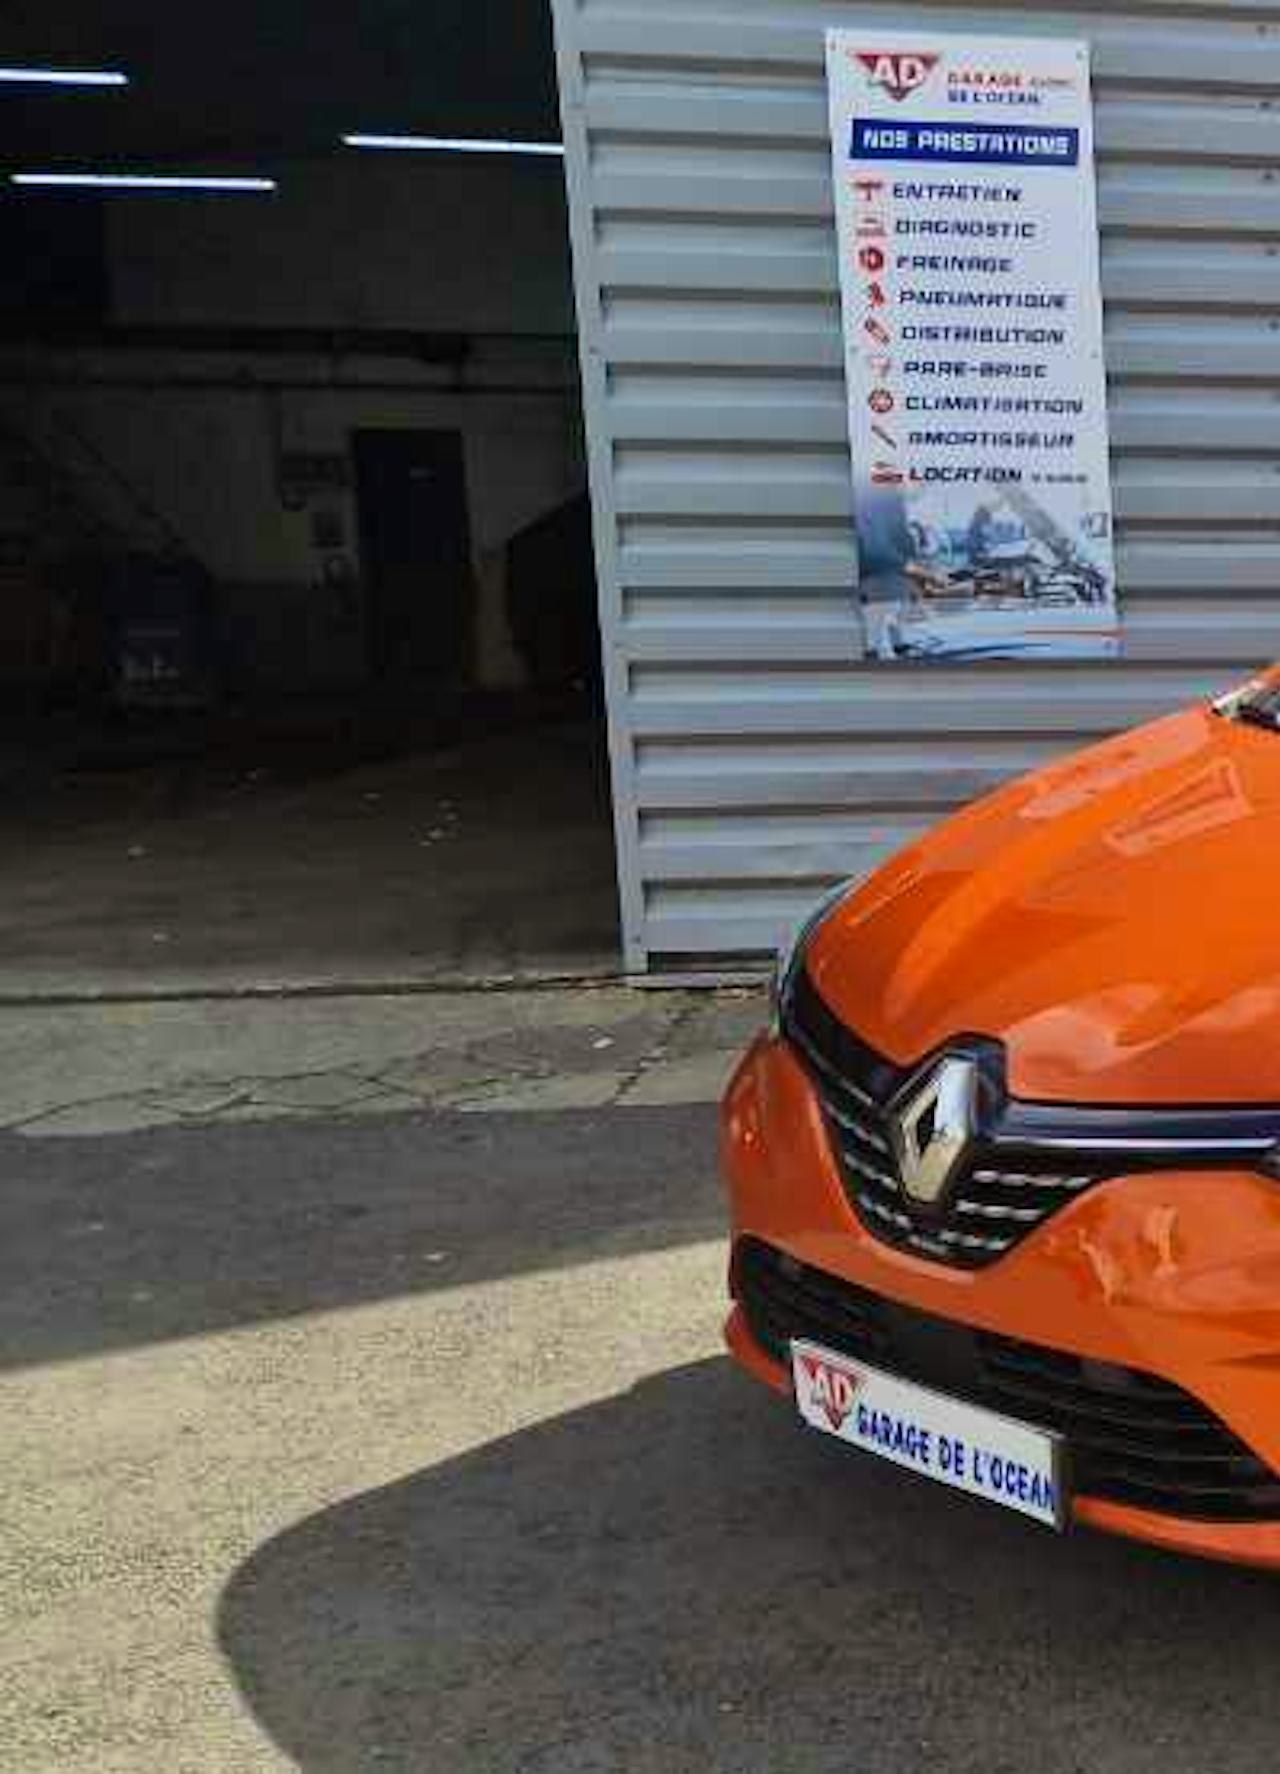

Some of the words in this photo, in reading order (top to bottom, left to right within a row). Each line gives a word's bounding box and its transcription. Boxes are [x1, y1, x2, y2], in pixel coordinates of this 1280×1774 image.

[873, 55, 926, 88] AD
[947, 72, 1023, 88] GARAGE
[862, 129, 908, 150] NOS
[917, 130, 1071, 156] PRESTATIONS
[892, 181, 1023, 203] ENTRETIEN
[895, 218, 1037, 239] DIAGNOSTIC
[897, 254, 1014, 274] FREINAGE
[899, 289, 1069, 310] PNEUMATIQUE
[901, 325, 1067, 345] DISTRIBUTION
[903, 360, 1048, 380] PARE-BRISE
[905, 396, 1084, 415] CLIMATISATION
[908, 431, 1076, 450] AMORTISSEUR
[908, 467, 1024, 484] LOCATION
[856, 1403, 930, 1465] GARAGE
[938, 1435, 965, 1478] DE
